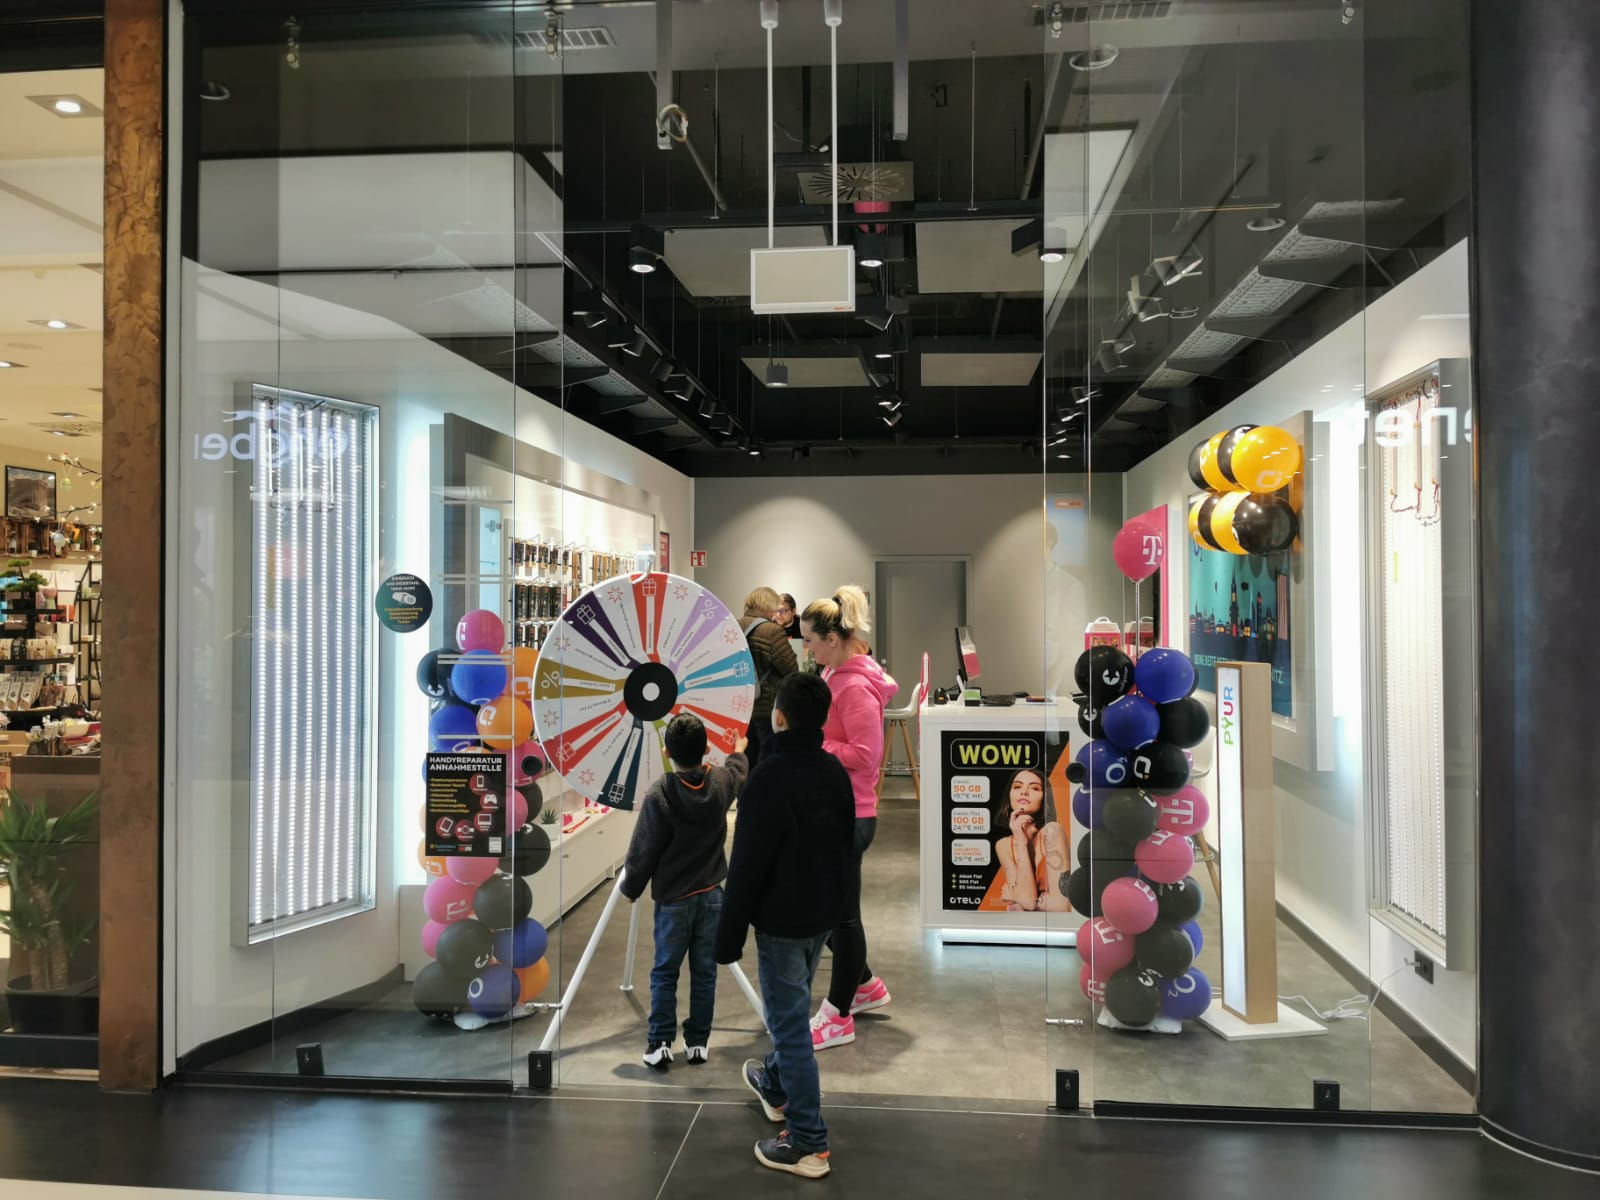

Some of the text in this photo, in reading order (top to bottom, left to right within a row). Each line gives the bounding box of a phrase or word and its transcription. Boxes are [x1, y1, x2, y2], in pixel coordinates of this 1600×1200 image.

[1142, 535, 1163, 565] T
[958, 744, 1031, 766] WOW!
[429, 756, 502, 764] HANDYREPARATUR
[429, 764, 502, 772] ANNAHMESTELLE
[953, 784, 981, 793] 50 GB
[953, 816, 984, 825] 100 GB
